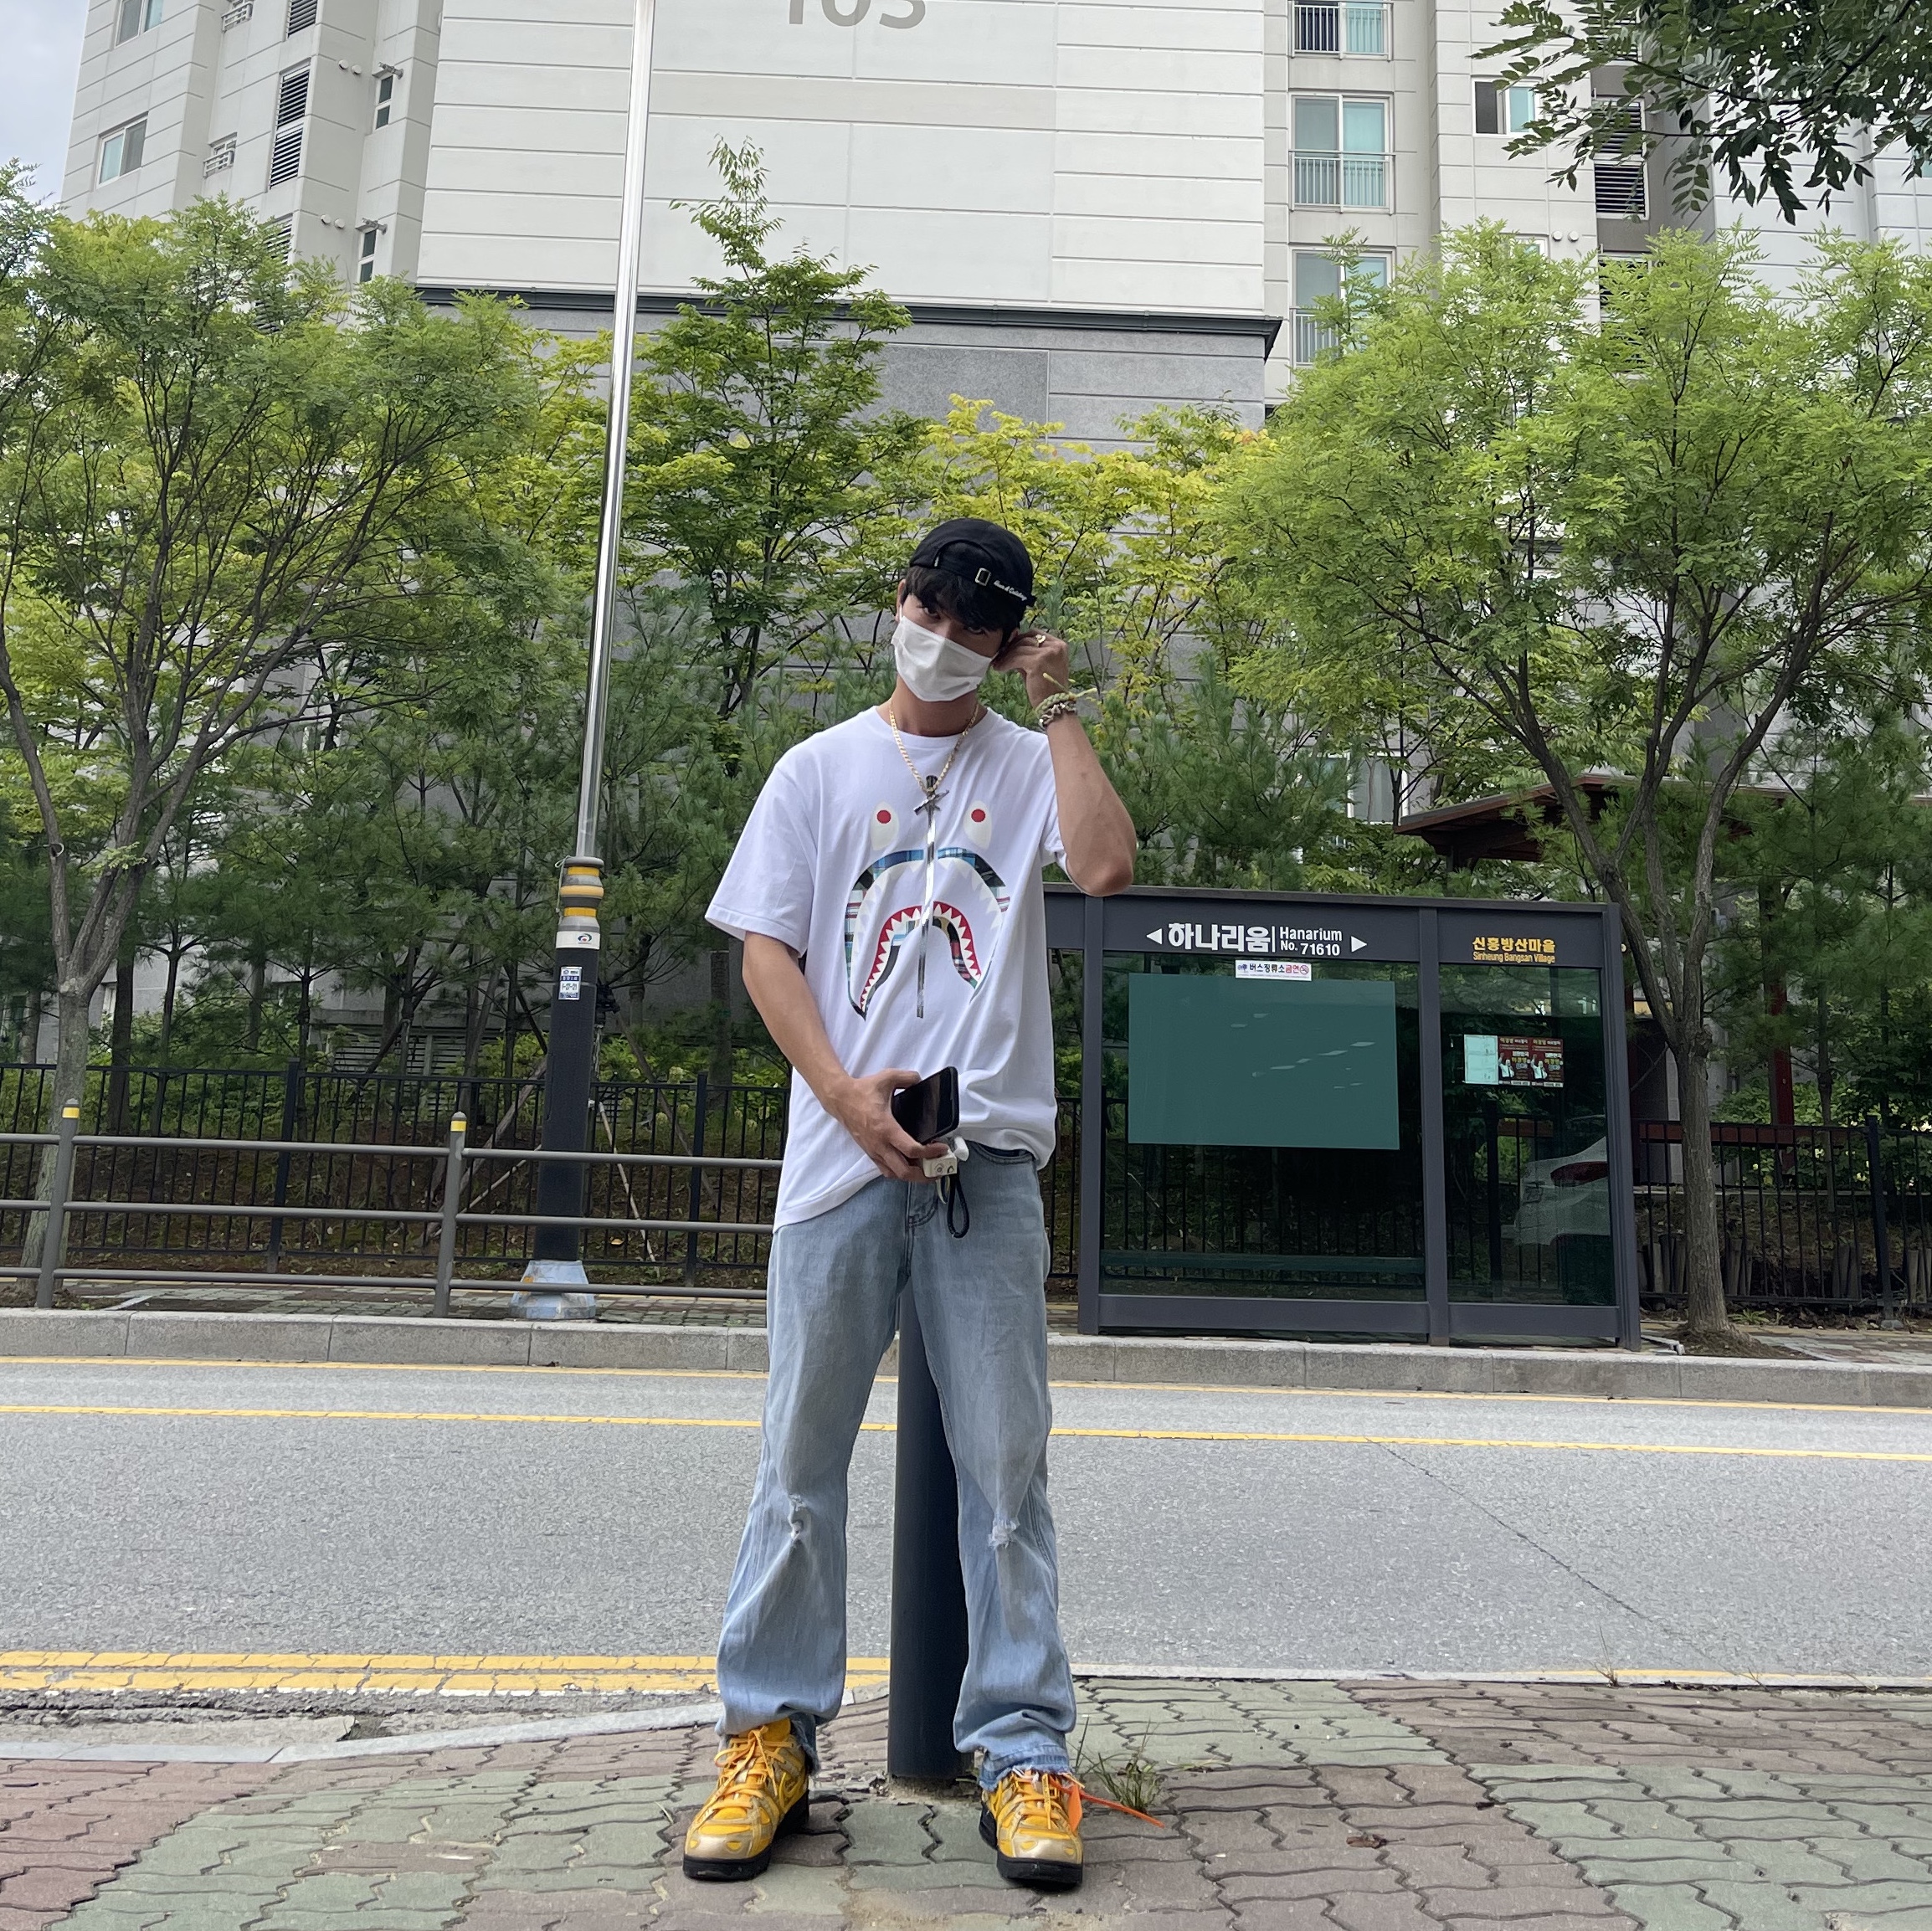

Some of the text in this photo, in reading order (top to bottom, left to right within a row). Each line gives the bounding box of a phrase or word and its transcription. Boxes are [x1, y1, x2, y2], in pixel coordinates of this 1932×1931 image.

[1168, 922, 1272, 953] 하나리움
[1280, 927, 1343, 942] Hanarium
[1280, 940, 1340, 956] No. 71610
[1472, 937, 1555, 953] 신흥방산마을
[1473, 952, 1555, 964] Sinheung Bangsan Village
